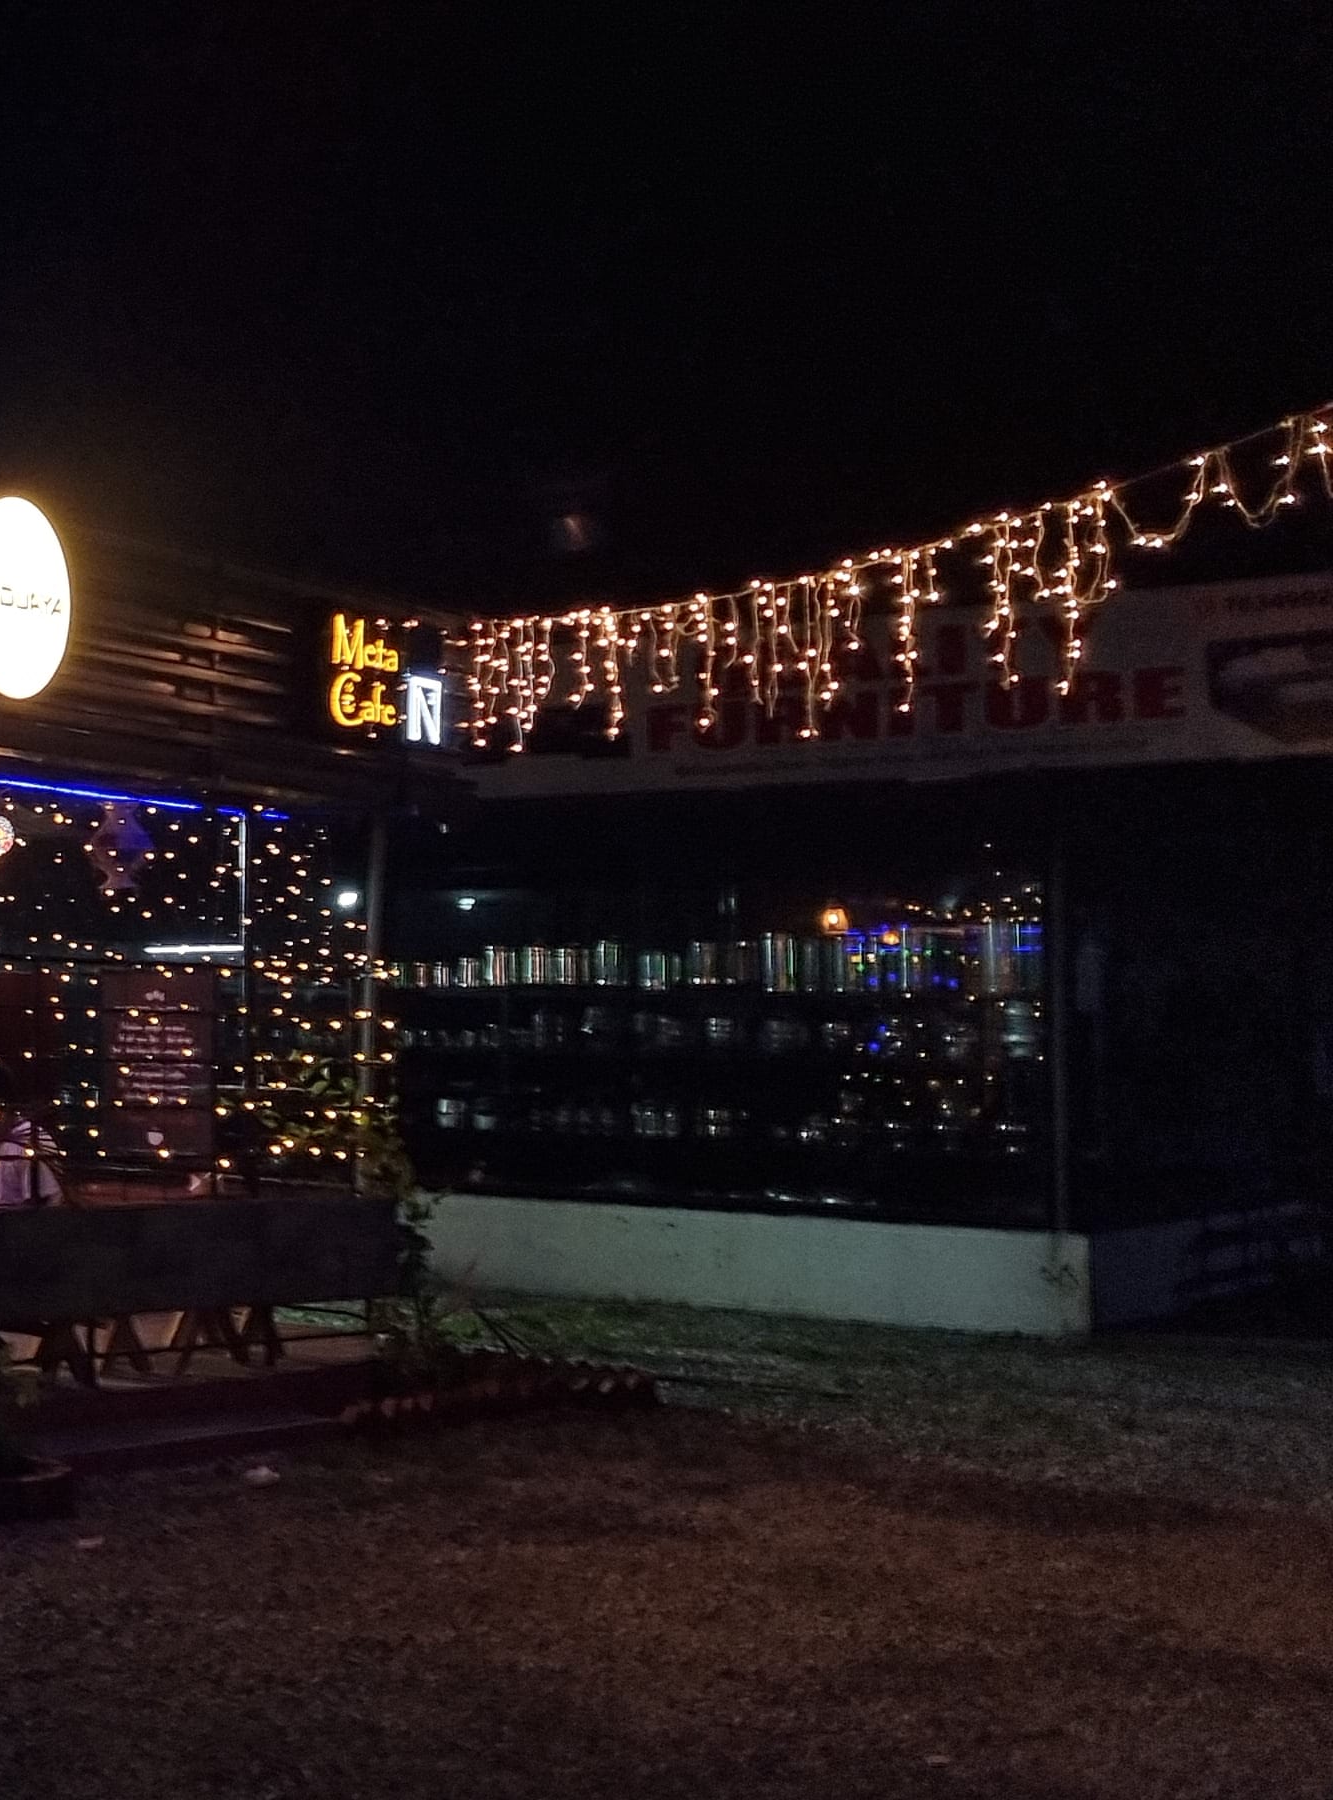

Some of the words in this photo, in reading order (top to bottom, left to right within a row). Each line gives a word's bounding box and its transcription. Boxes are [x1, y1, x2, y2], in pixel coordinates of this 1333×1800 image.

[332, 613, 398, 672] Meta
[330, 672, 396, 726] Cafe
[649, 666, 1187, 751] FURNITURE
